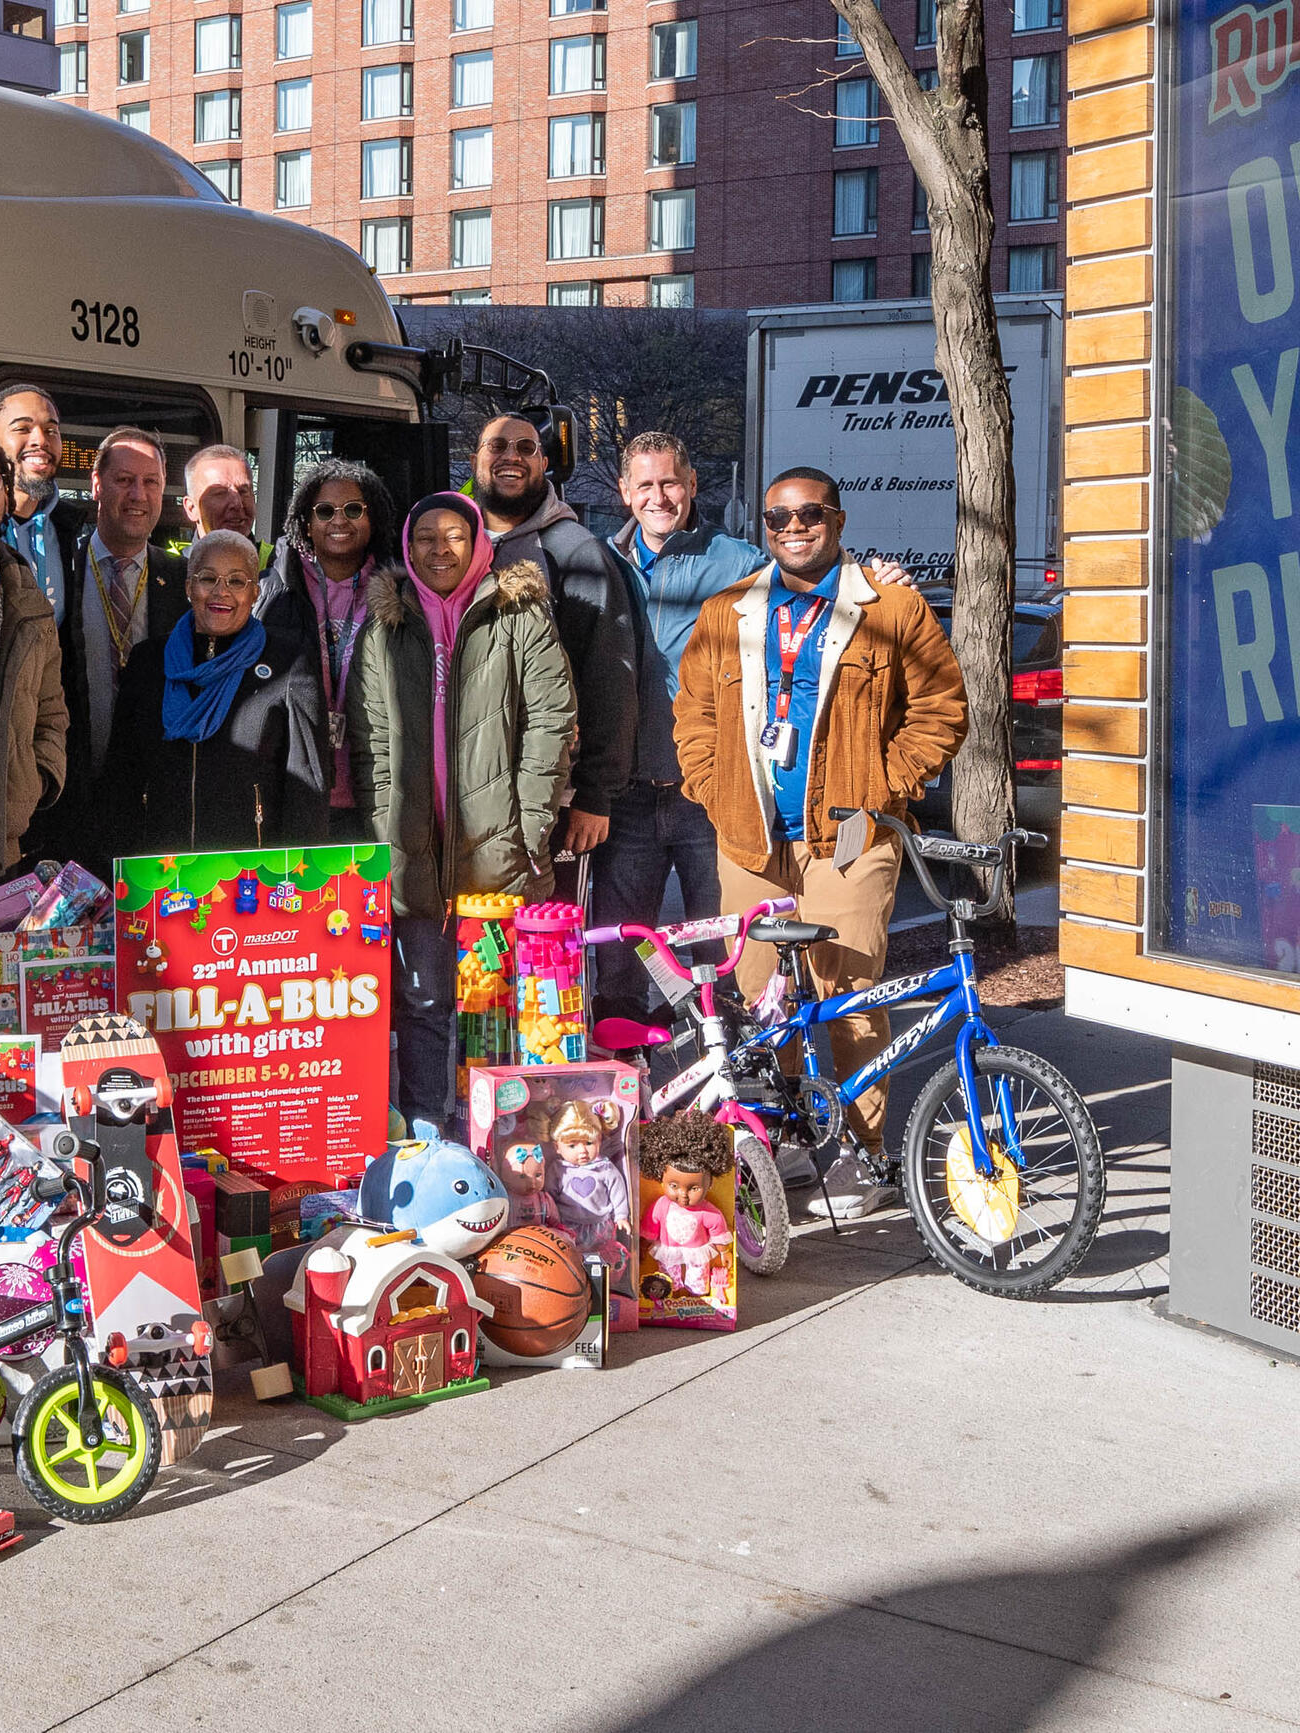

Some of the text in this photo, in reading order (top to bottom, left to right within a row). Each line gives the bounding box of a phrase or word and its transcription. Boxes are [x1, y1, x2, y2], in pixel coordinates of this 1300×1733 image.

[1209, 0, 1300, 124] RU
[1227, 142, 1300, 325] O
[70, 298, 141, 349] 3128
[243, 335, 277, 352] HEIGHT
[228, 349, 294, 383] 10'-10"
[795, 365, 1020, 410] PENS
[842, 409, 955, 432] Truck Renta
[837, 476, 956, 492] hold & Business
[1211, 549, 1300, 730] R
[243, 929, 300, 946] massDOT
[192, 952, 319, 981] 22nd Annual
[866, 972, 926, 1004] ROCK IT
[32, 997, 109, 1016] FILL-A-BUS
[128, 972, 381, 1033] FILL-A-BUS
[50, 1013, 70, 1024] with
[185, 1025, 325, 1060] with gifts!
[873, 1013, 932, 1073] HUFFY
[169, 1058, 343, 1090] DECEMBER 5-9, 2022
[186, 1085, 323, 1103] The bus will make the following stops:
[231, 1101, 278, 1112] Wednesday, 12/7
[279, 1099, 307, 1108] Thursday,
[327, 1095, 346, 1104] Friday,
[514, 1246, 557, 1268] COURT
[575, 1342, 600, 1355] FEEL
